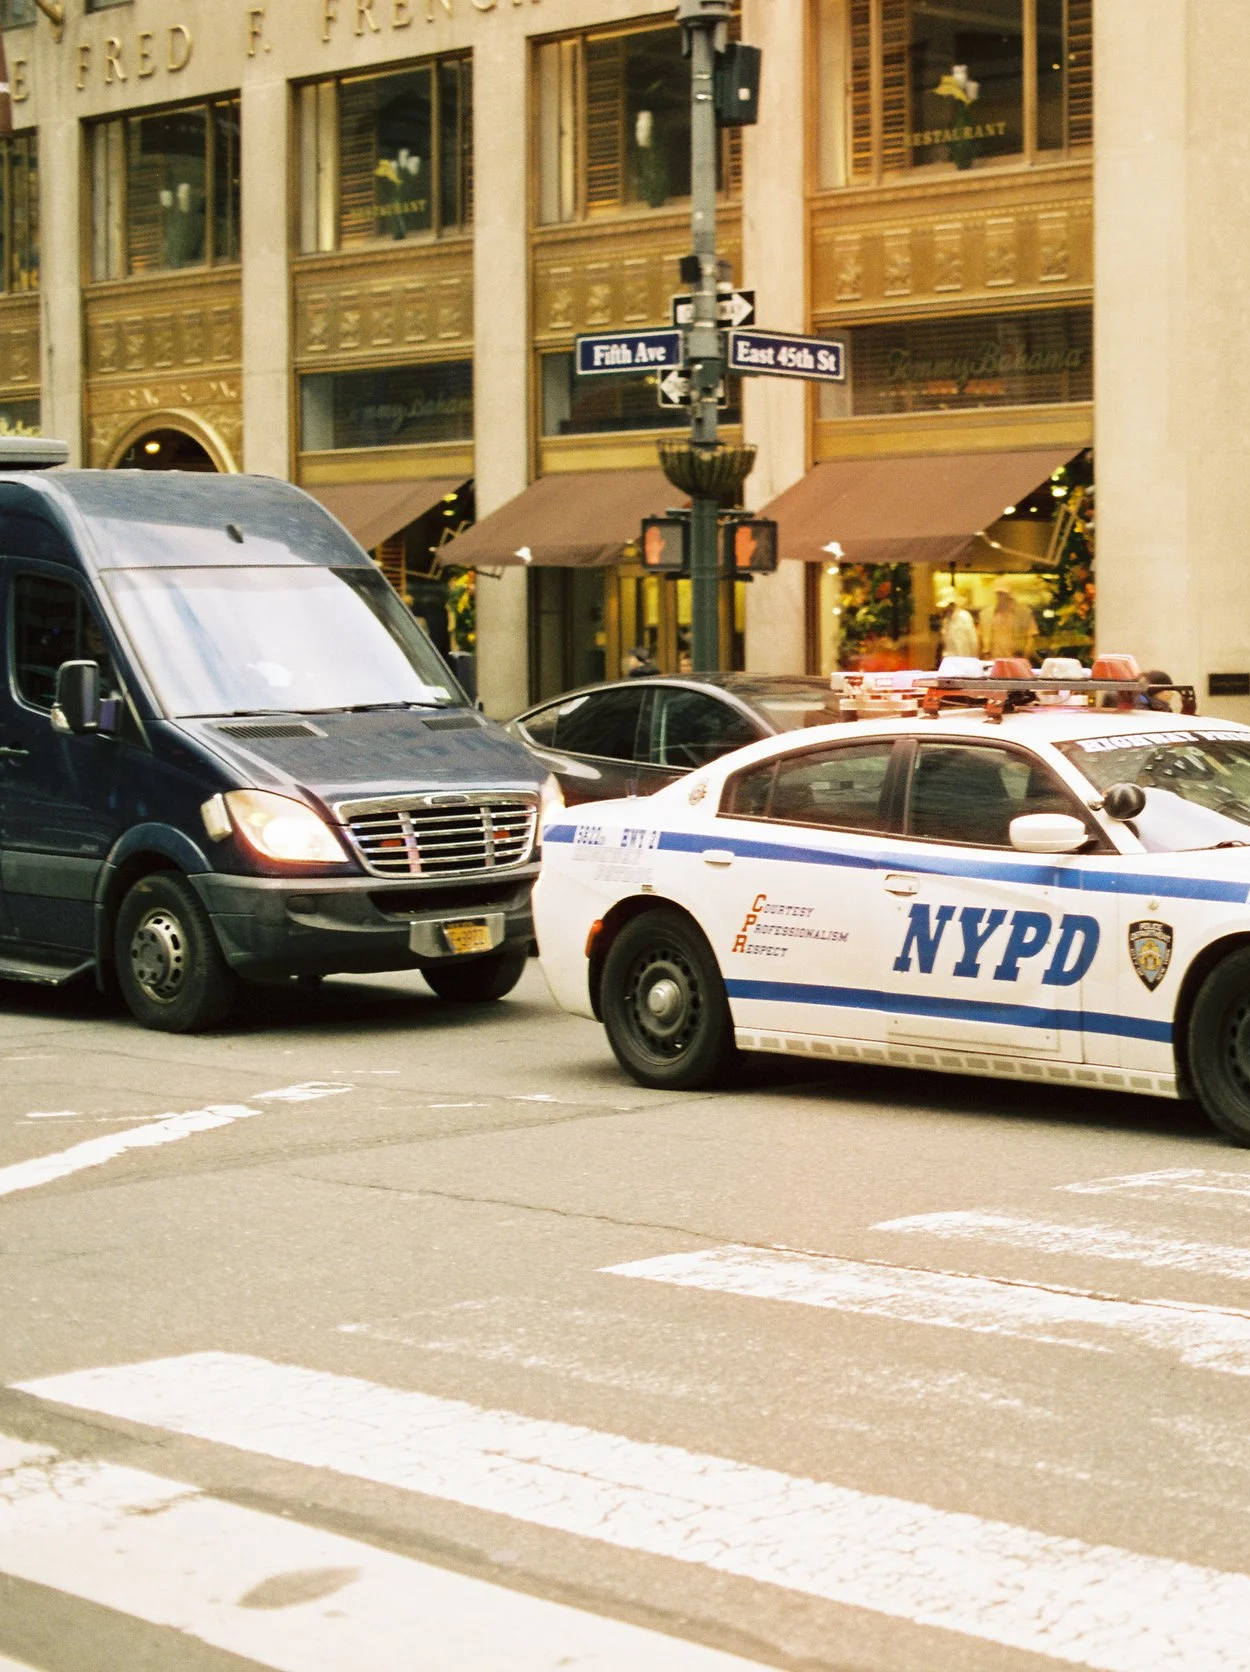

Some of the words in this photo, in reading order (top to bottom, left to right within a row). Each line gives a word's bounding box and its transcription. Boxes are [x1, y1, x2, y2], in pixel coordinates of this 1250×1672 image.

[76, 23, 194, 91] FRED
[246, 7, 272, 58] F.
[322, 0, 541, 43] FRE
[592, 342, 632, 367] Fifth
[634, 341, 667, 364] Ave
[736, 340, 775, 366] East
[777, 346, 814, 370] 45th
[817, 350, 836, 372] St
[892, 903, 1100, 987] NYPD
